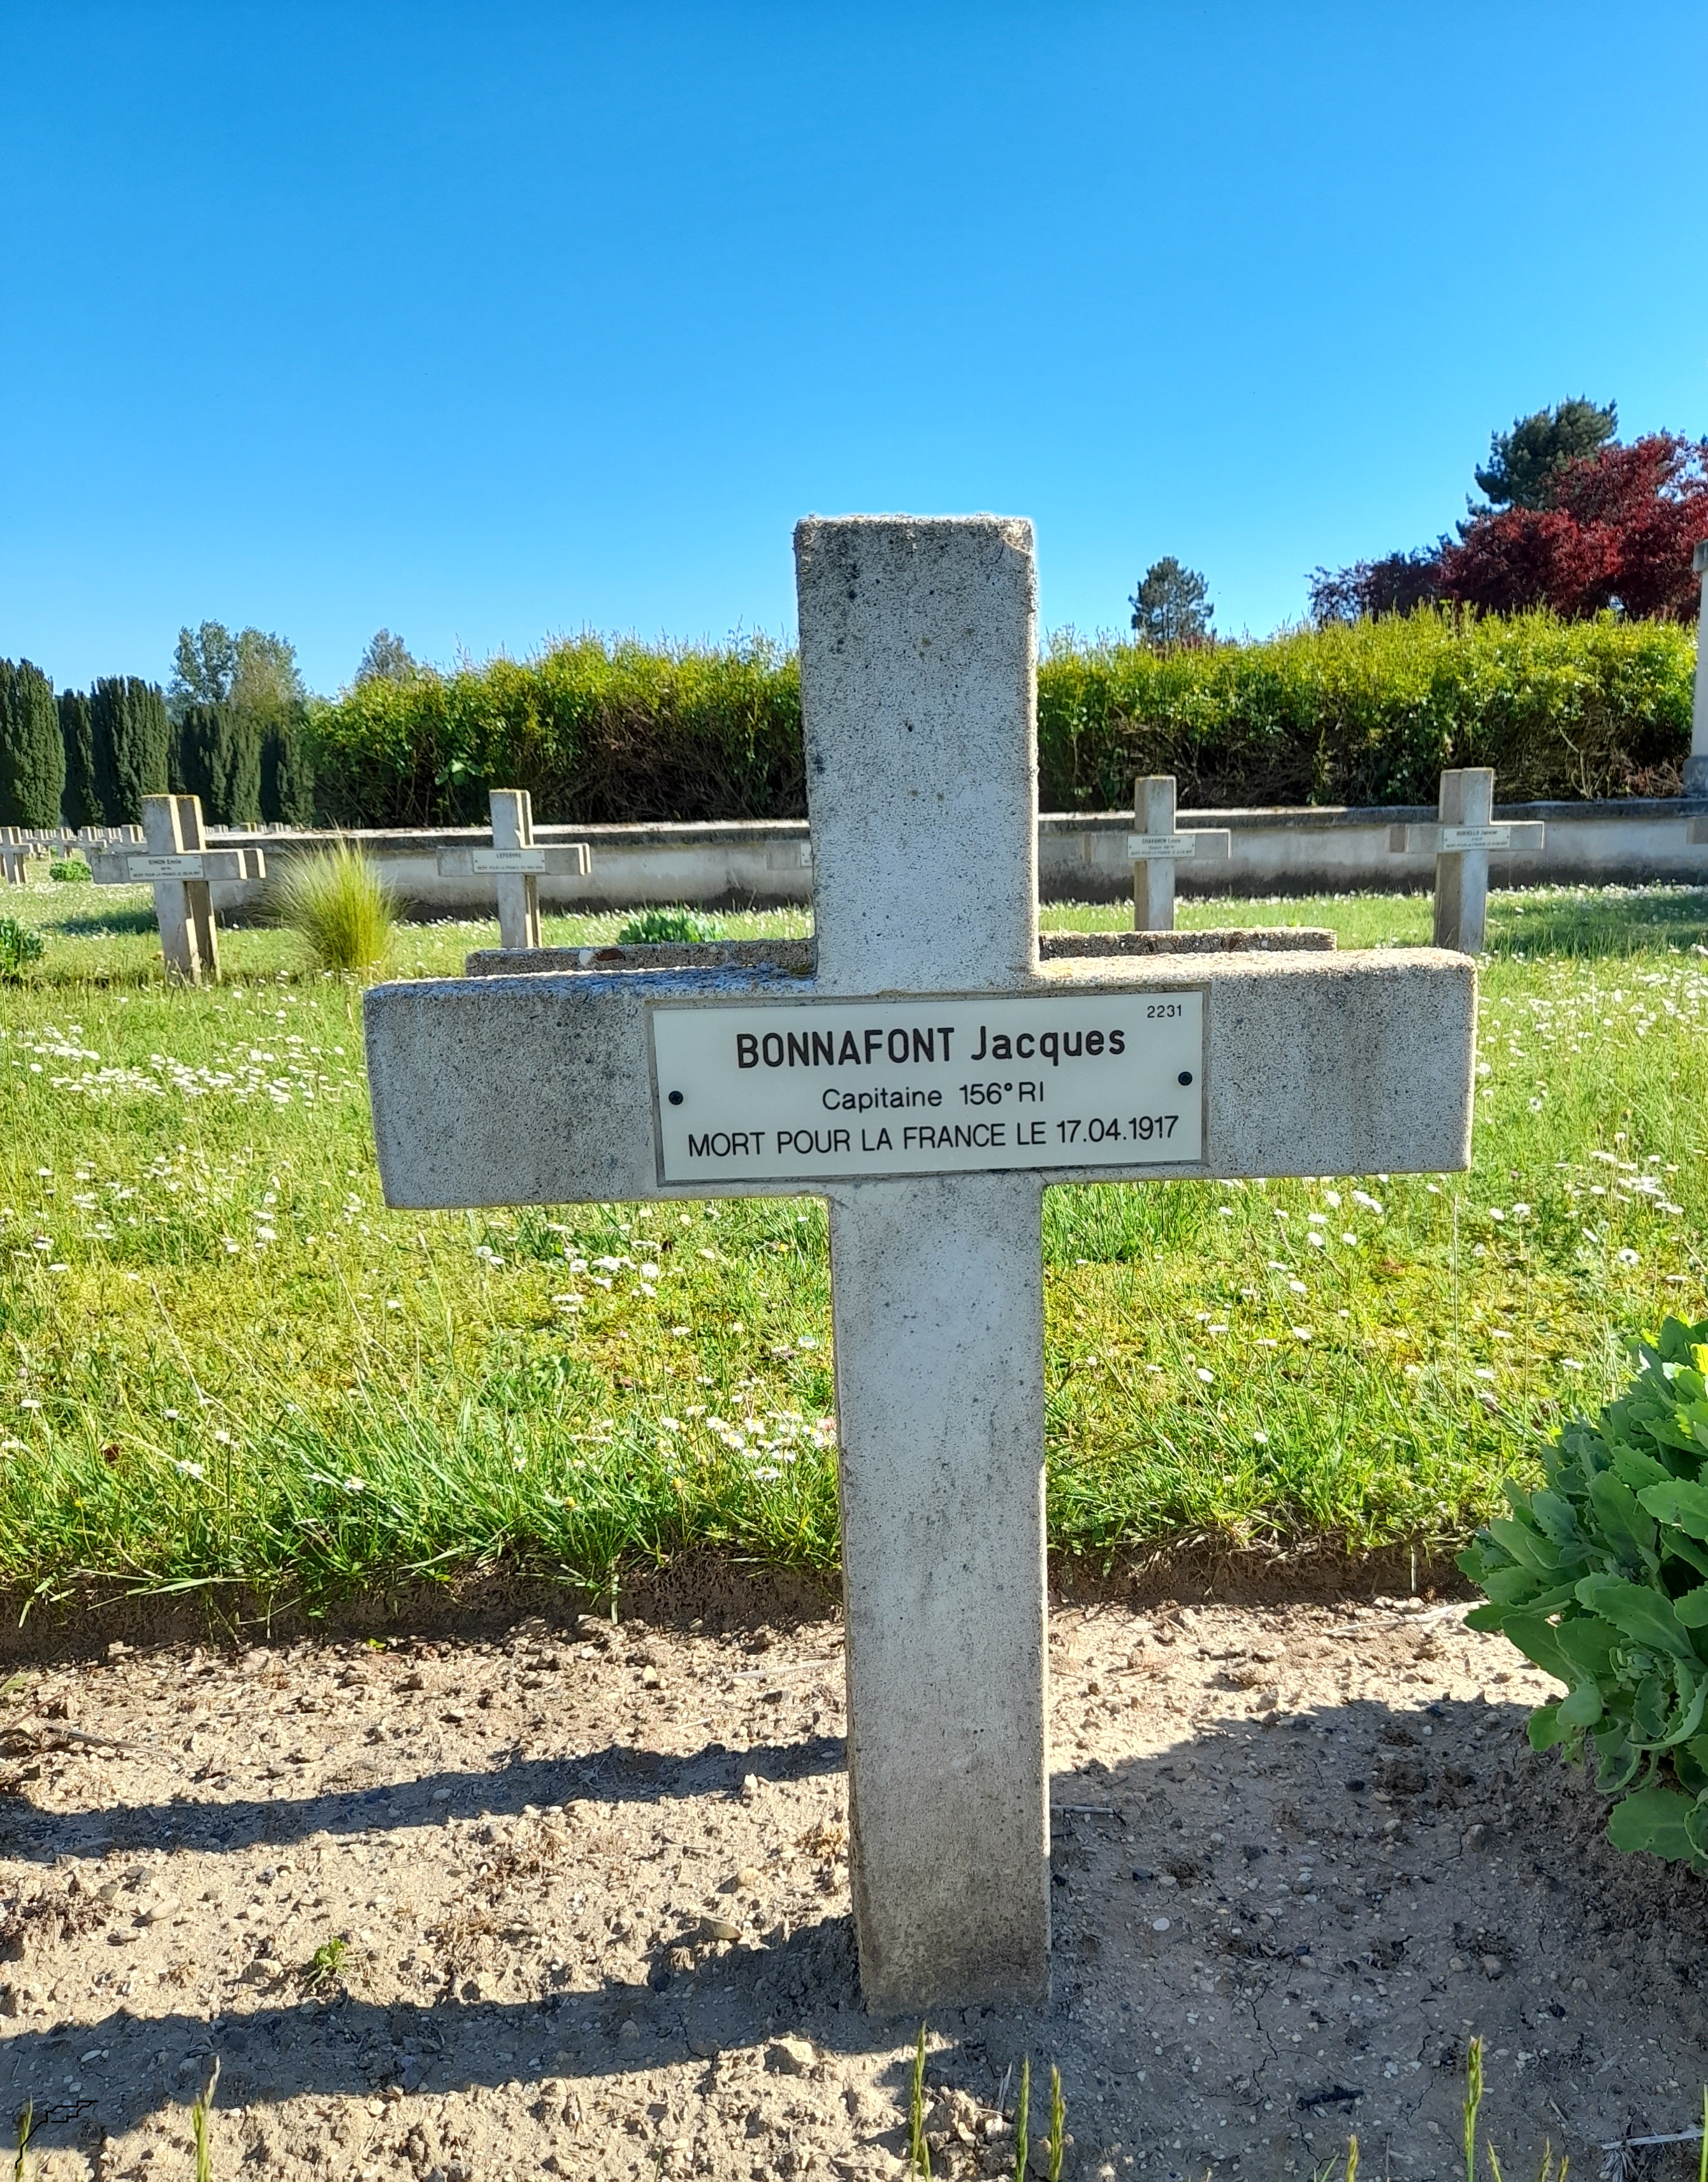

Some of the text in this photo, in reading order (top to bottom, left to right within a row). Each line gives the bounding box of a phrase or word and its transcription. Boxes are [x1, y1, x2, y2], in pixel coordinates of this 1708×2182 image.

[1147, 1004, 1182, 1018] 2231
[737, 1025, 1125, 1069] BONNAFONT Jacques
[822, 1087, 943, 1114] Capitaine
[688, 1115, 1179, 1157] MORT POUR LA FRANCE LE 17.04.1917
